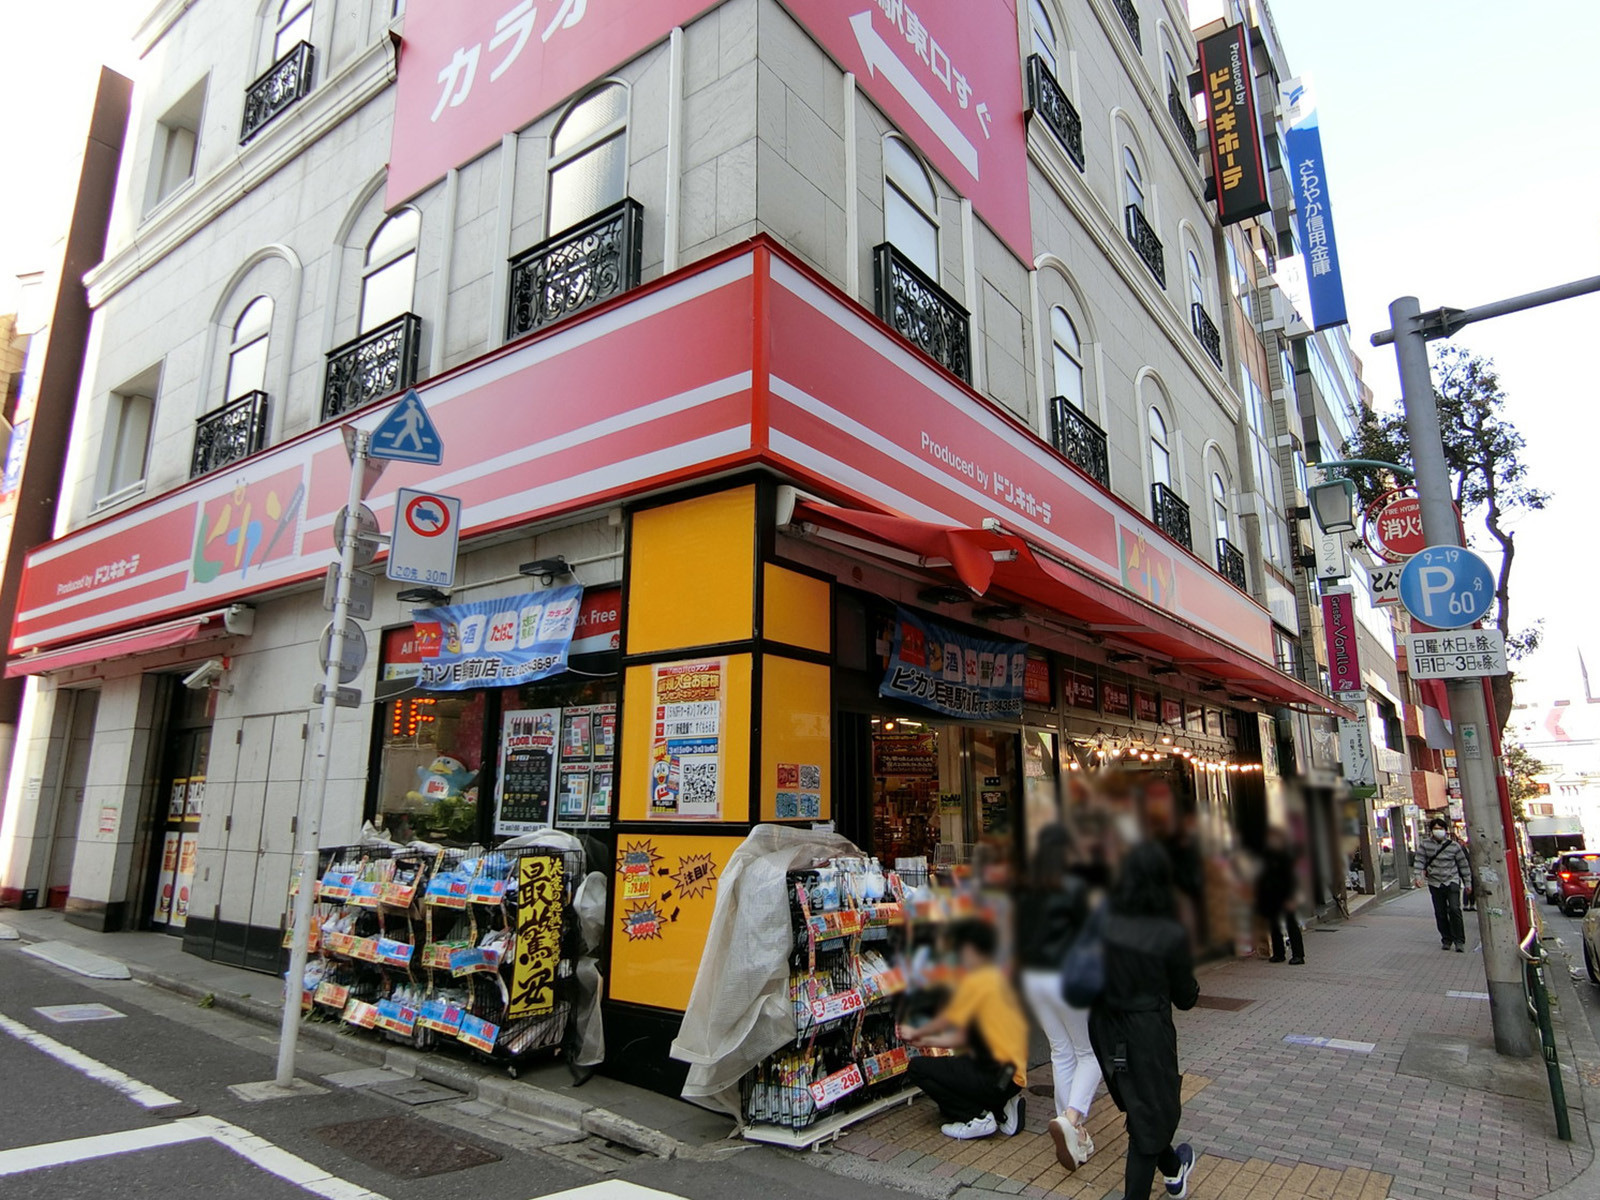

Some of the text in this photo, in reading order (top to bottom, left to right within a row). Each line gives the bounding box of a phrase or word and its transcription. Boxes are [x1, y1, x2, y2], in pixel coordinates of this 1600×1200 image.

[1229, 42, 1246, 106] Produced by
[1299, 158, 1331, 278] さわやか信用金庫
[921, 431, 974, 478] Produced
[976, 465, 989, 490] by
[1384, 506, 1399, 516] FIRE
[395, 566, 448, 583] この先 30m
[57, 576, 86, 595] Produced
[85, 575, 94, 589] by
[1418, 566, 1456, 617] P
[1449, 591, 1475, 615] 60
[590, 609, 617, 625] Free
[841, 994, 862, 1011] 298
[841, 1070, 861, 1090] 298
